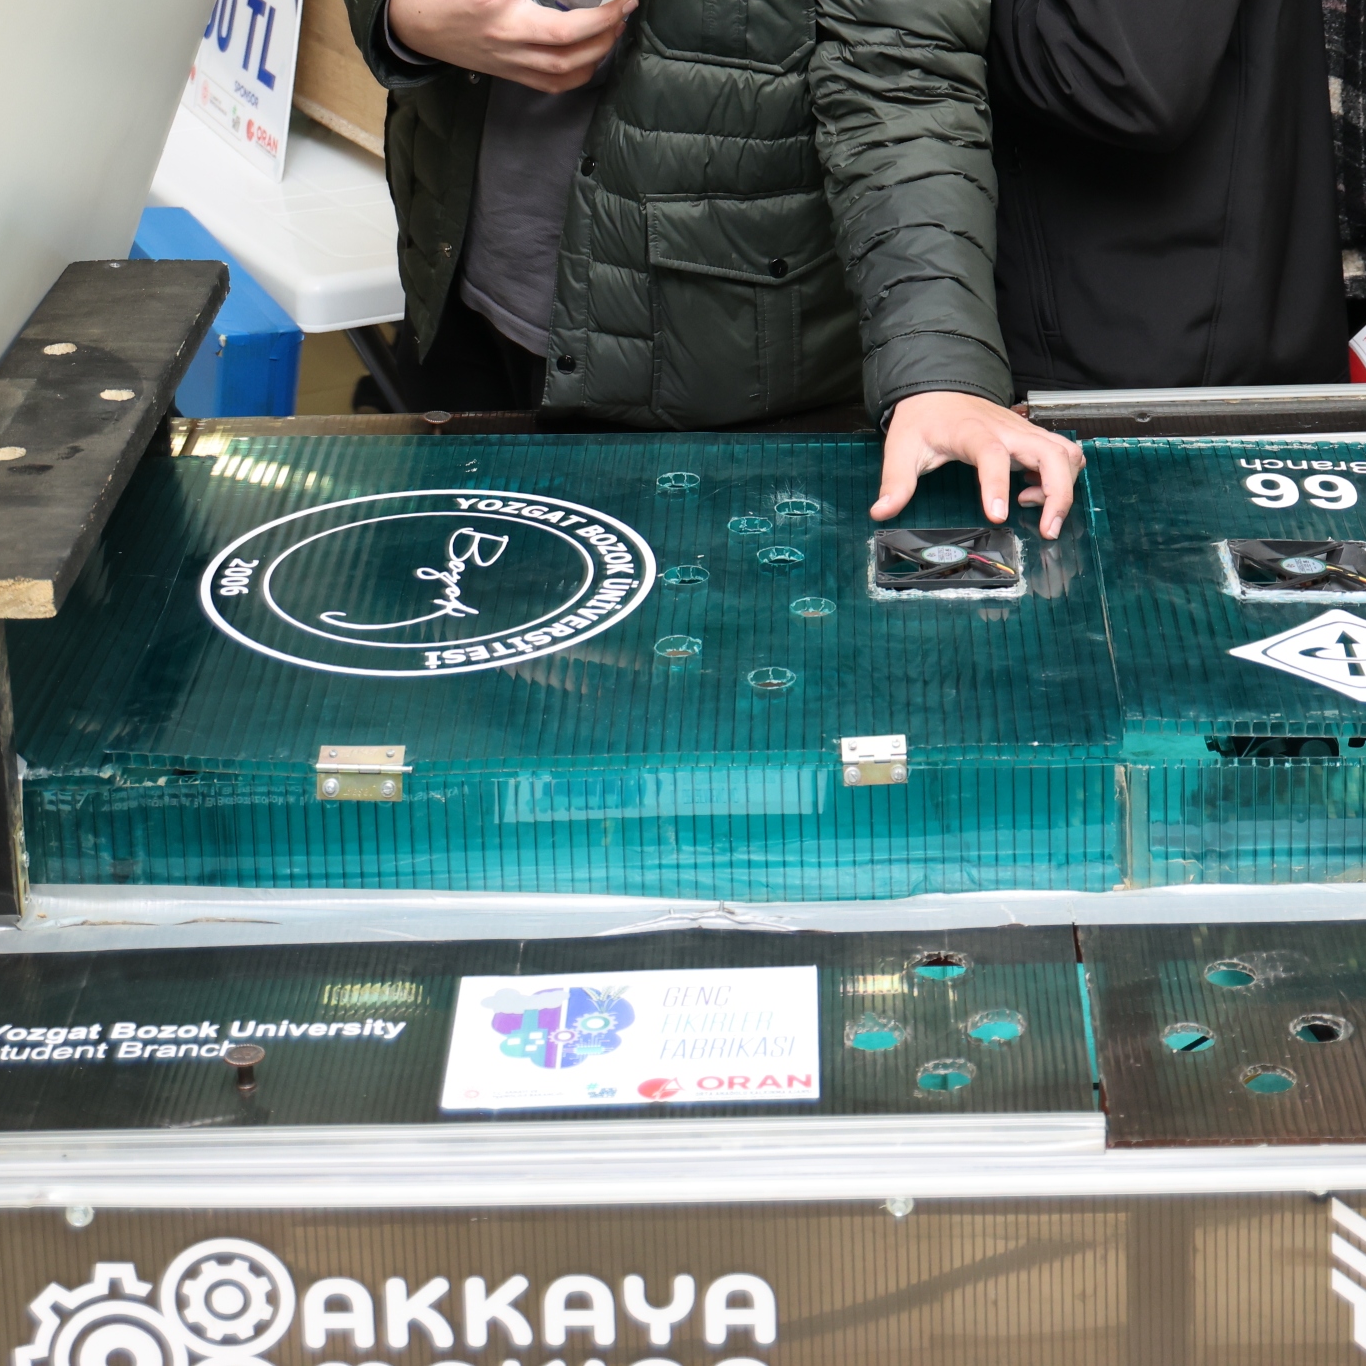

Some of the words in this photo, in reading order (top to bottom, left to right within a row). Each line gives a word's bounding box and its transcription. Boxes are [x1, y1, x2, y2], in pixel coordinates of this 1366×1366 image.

[234, 80, 260, 110] SPONSOR
[256, 125, 279, 154] ORAN
[1243, 471, 1359, 511] 66
[456, 497, 587, 527] YOZGAT
[575, 524, 635, 575] BOZOK
[220, 556, 259, 597] 2006
[424, 577, 640, 669] ÜNİVERSİTESİ
[662, 985, 732, 1008] GENÇ
[109, 1020, 220, 1040] Bozok
[228, 1018, 406, 1041] University
[116, 1037, 237, 1061] Branch
[696, 1073, 813, 1091] ORAN
[303, 1272, 777, 1350] AKKAYA
